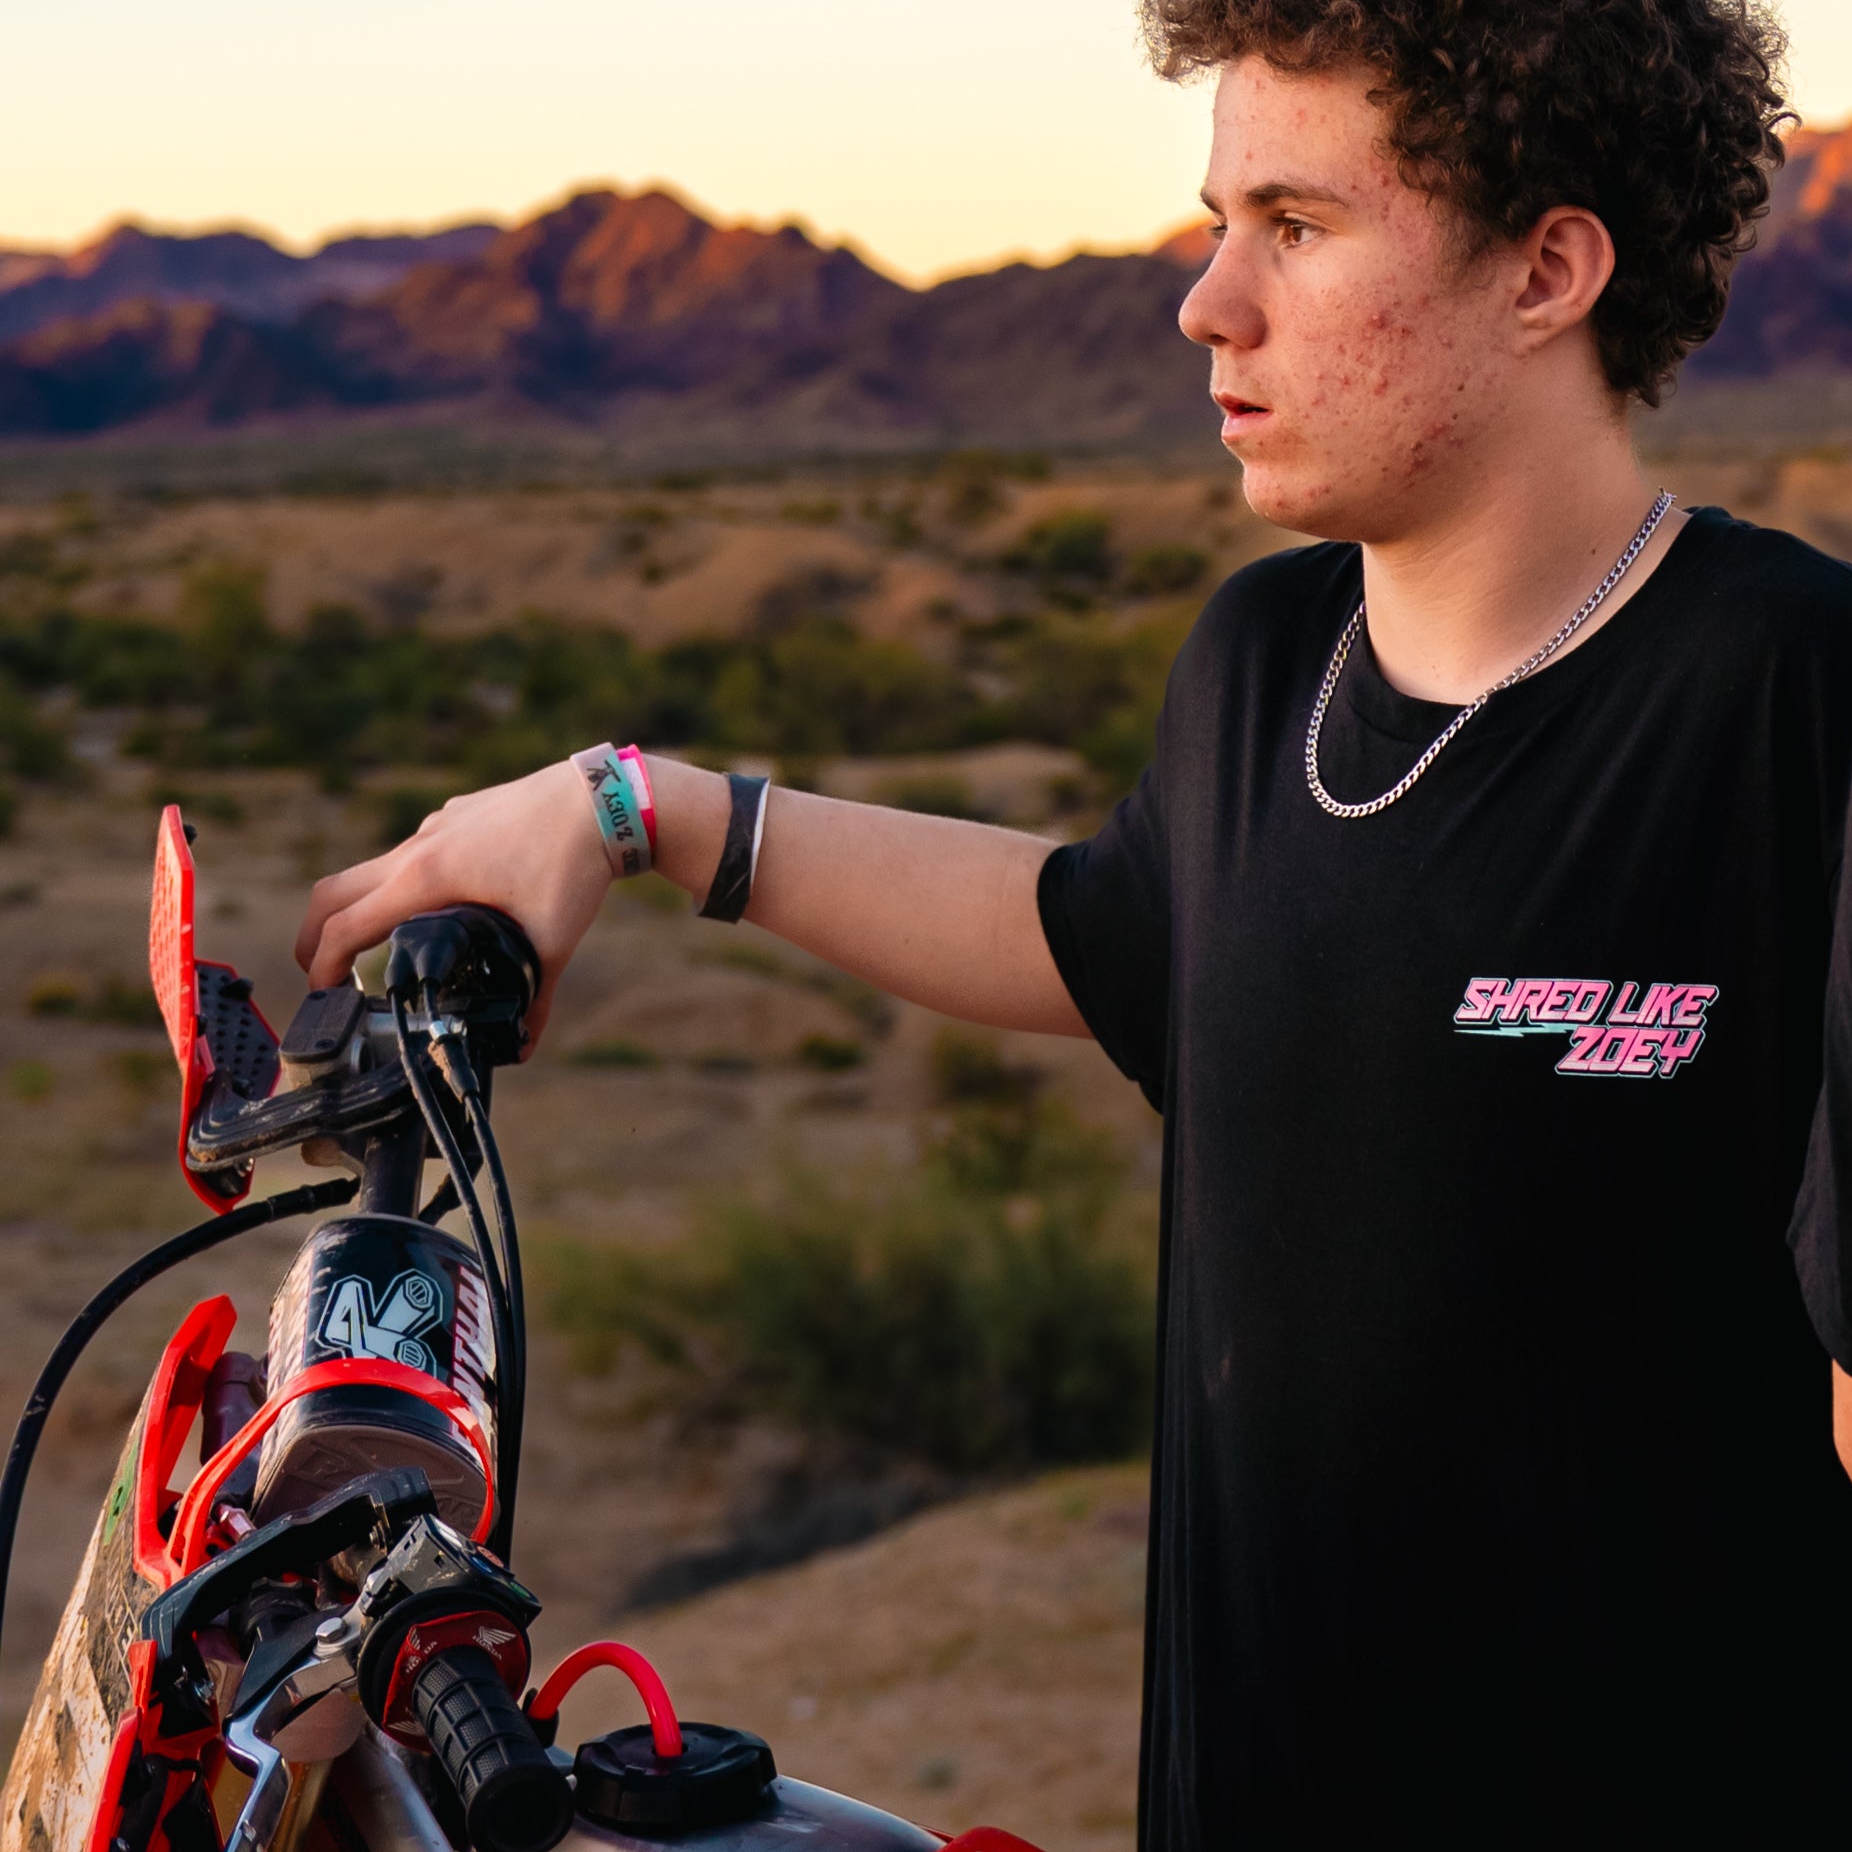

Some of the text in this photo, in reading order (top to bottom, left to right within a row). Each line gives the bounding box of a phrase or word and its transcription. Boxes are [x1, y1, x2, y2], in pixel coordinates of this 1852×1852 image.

[1455, 979, 1718, 1026] SHRED LIKE
[1556, 1026, 1704, 1077] ZOEY
